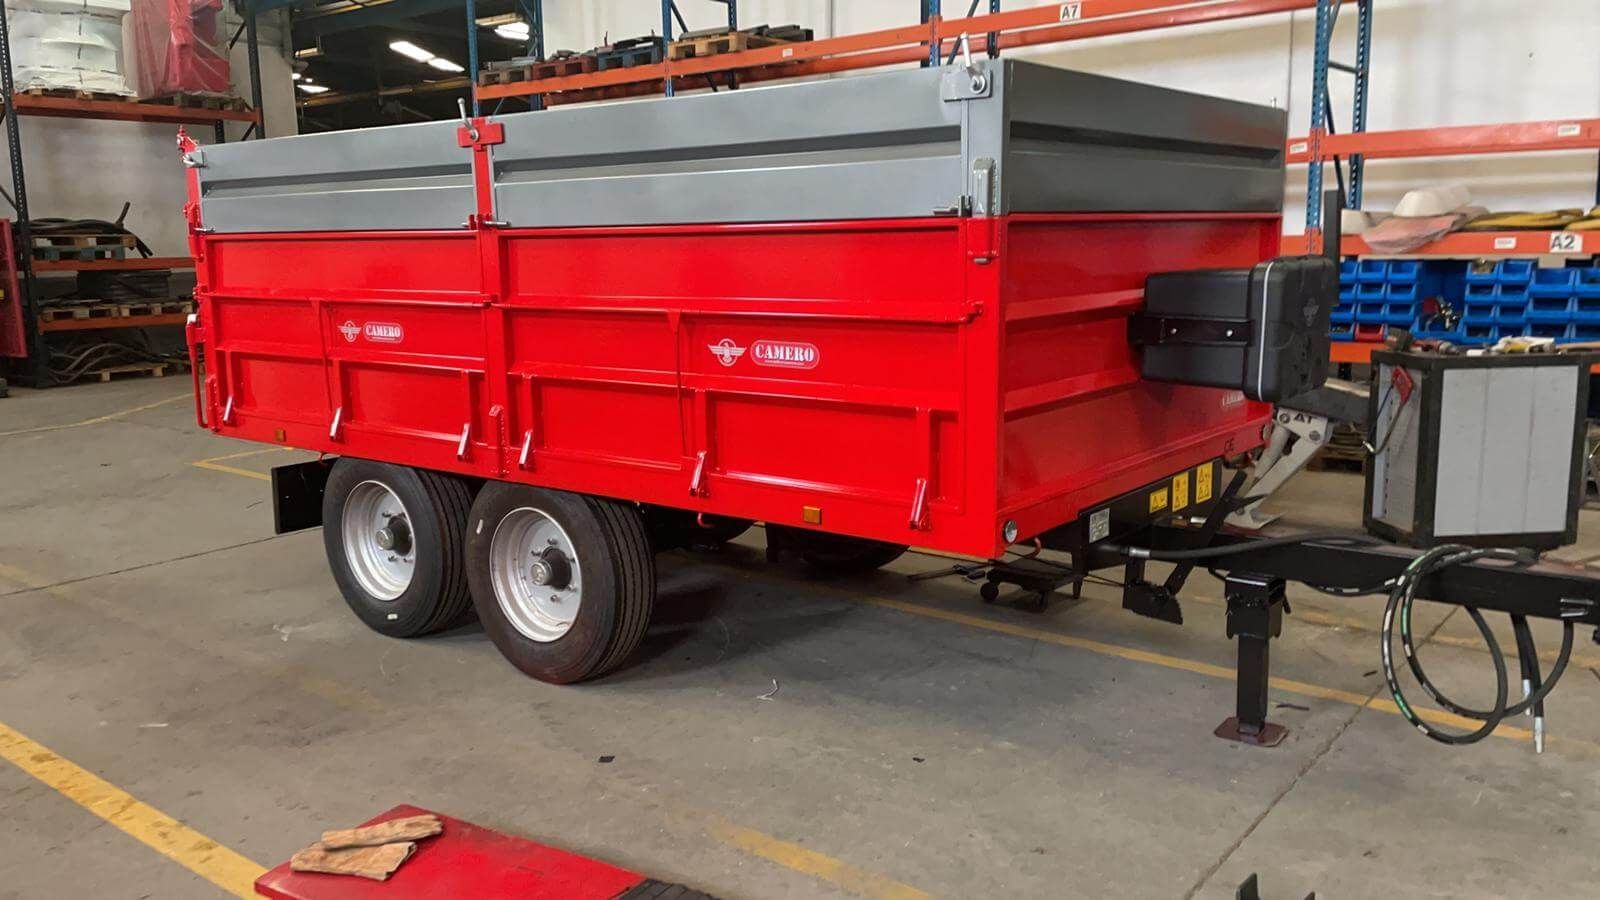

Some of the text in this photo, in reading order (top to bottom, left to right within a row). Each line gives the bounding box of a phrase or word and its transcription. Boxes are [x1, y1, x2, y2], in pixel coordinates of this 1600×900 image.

[1062, 5, 1078, 18] A7
[1551, 235, 1575, 249] A2
[365, 325, 401, 338] CAMERO
[755, 344, 814, 362] CAMERO
